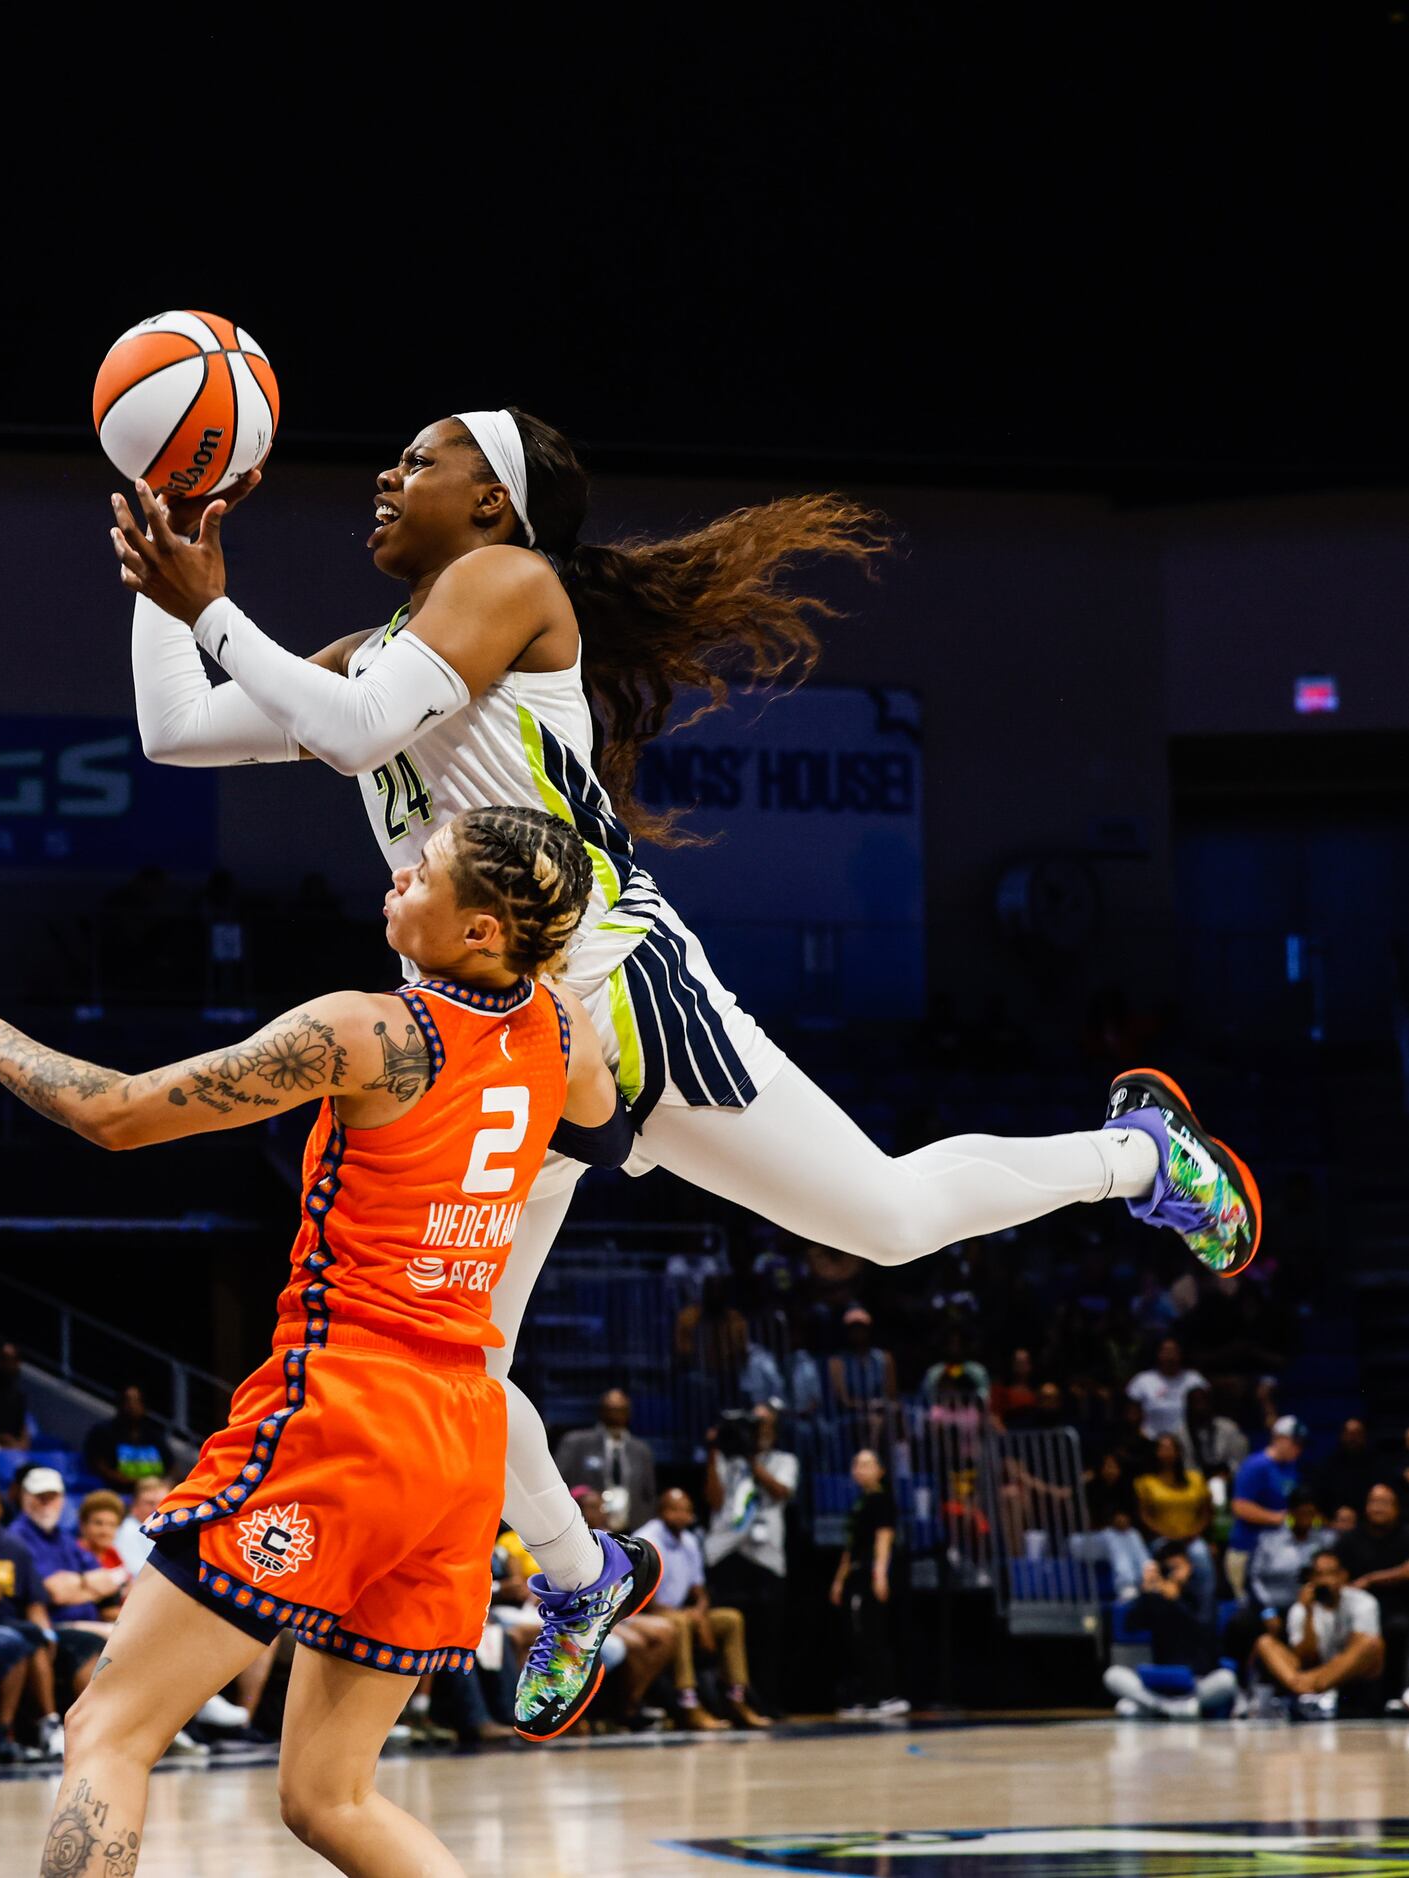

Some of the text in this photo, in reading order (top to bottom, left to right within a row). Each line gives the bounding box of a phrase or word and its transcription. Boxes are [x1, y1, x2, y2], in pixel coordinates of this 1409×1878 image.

[371, 749, 433, 845] 24
[461, 1086, 530, 1194] 2
[448, 1260, 497, 1293] AT&T
[75, 1778, 110, 1828] BLM
